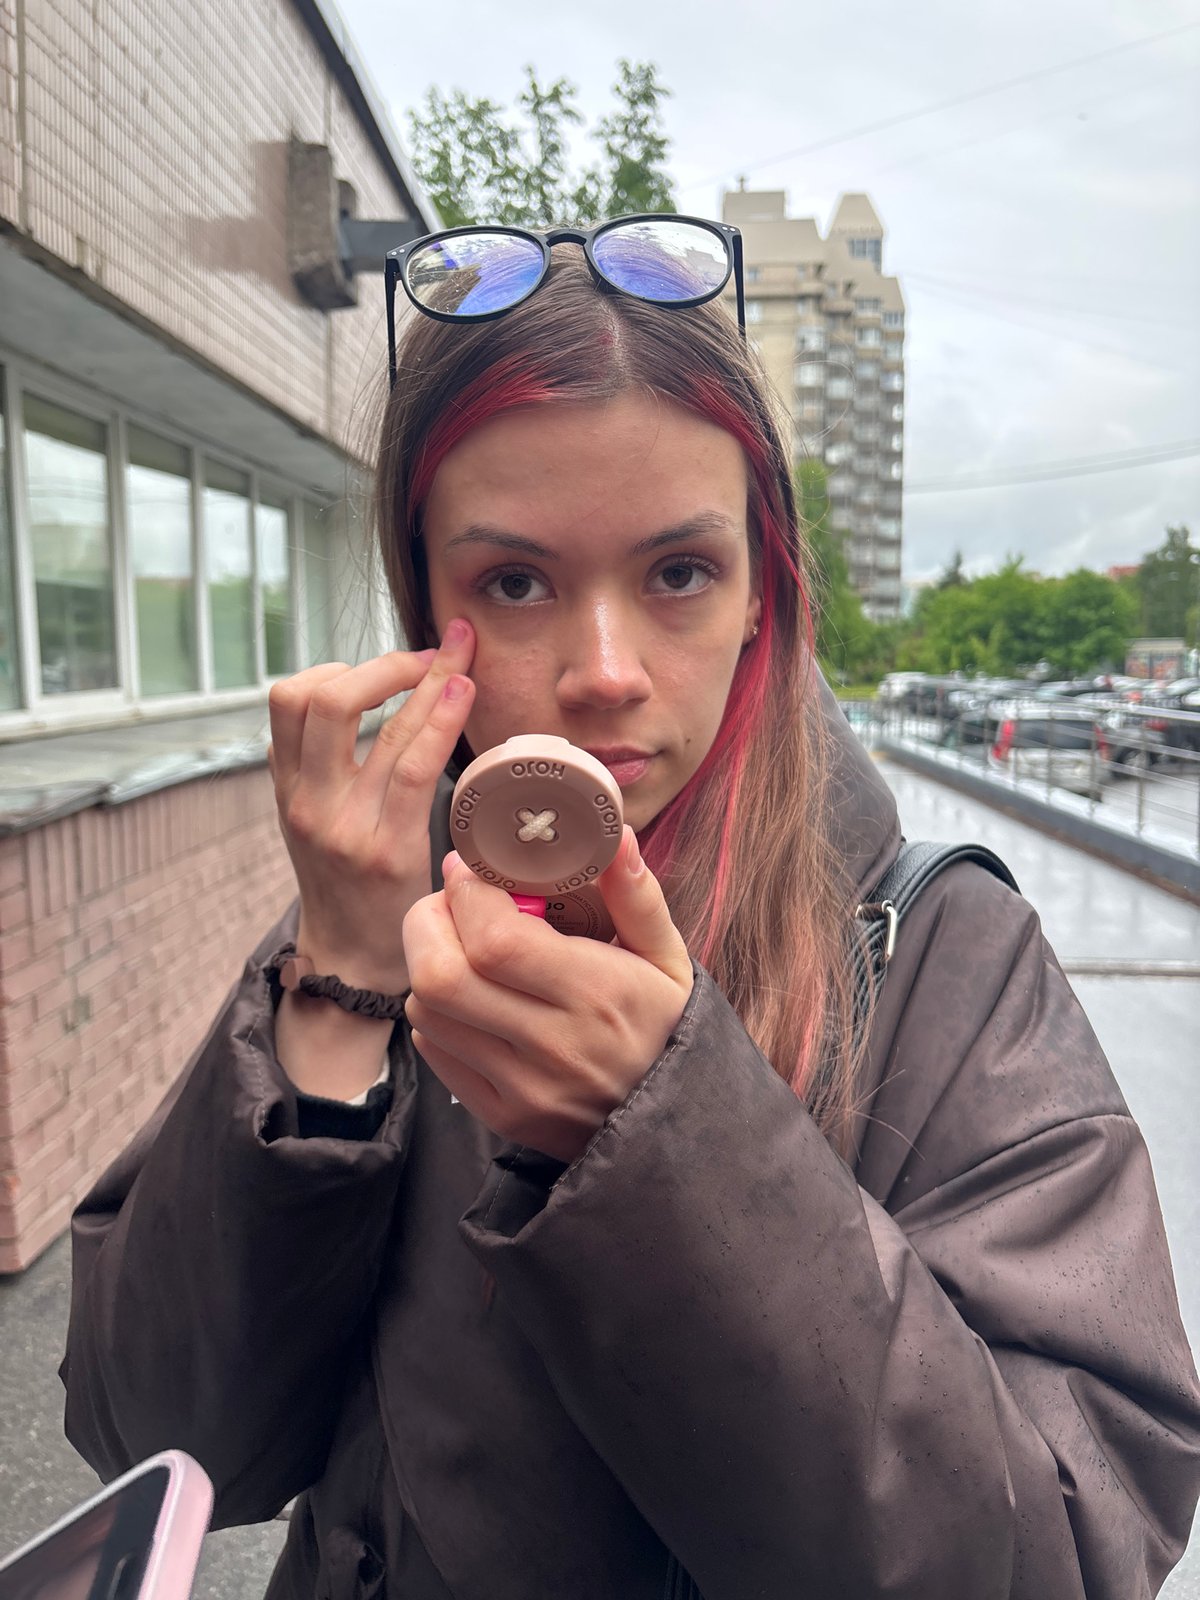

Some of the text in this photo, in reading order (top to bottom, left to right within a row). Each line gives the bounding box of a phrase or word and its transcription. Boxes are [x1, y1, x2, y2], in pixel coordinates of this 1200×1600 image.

[511, 761, 565, 778] HOJO
[456, 787, 481, 831] HOJO
[594, 794, 619, 837] HOJO
[471, 861, 516, 889] HOJO
[555, 865, 599, 892] HOJO
[546, 902, 565, 910] JO
